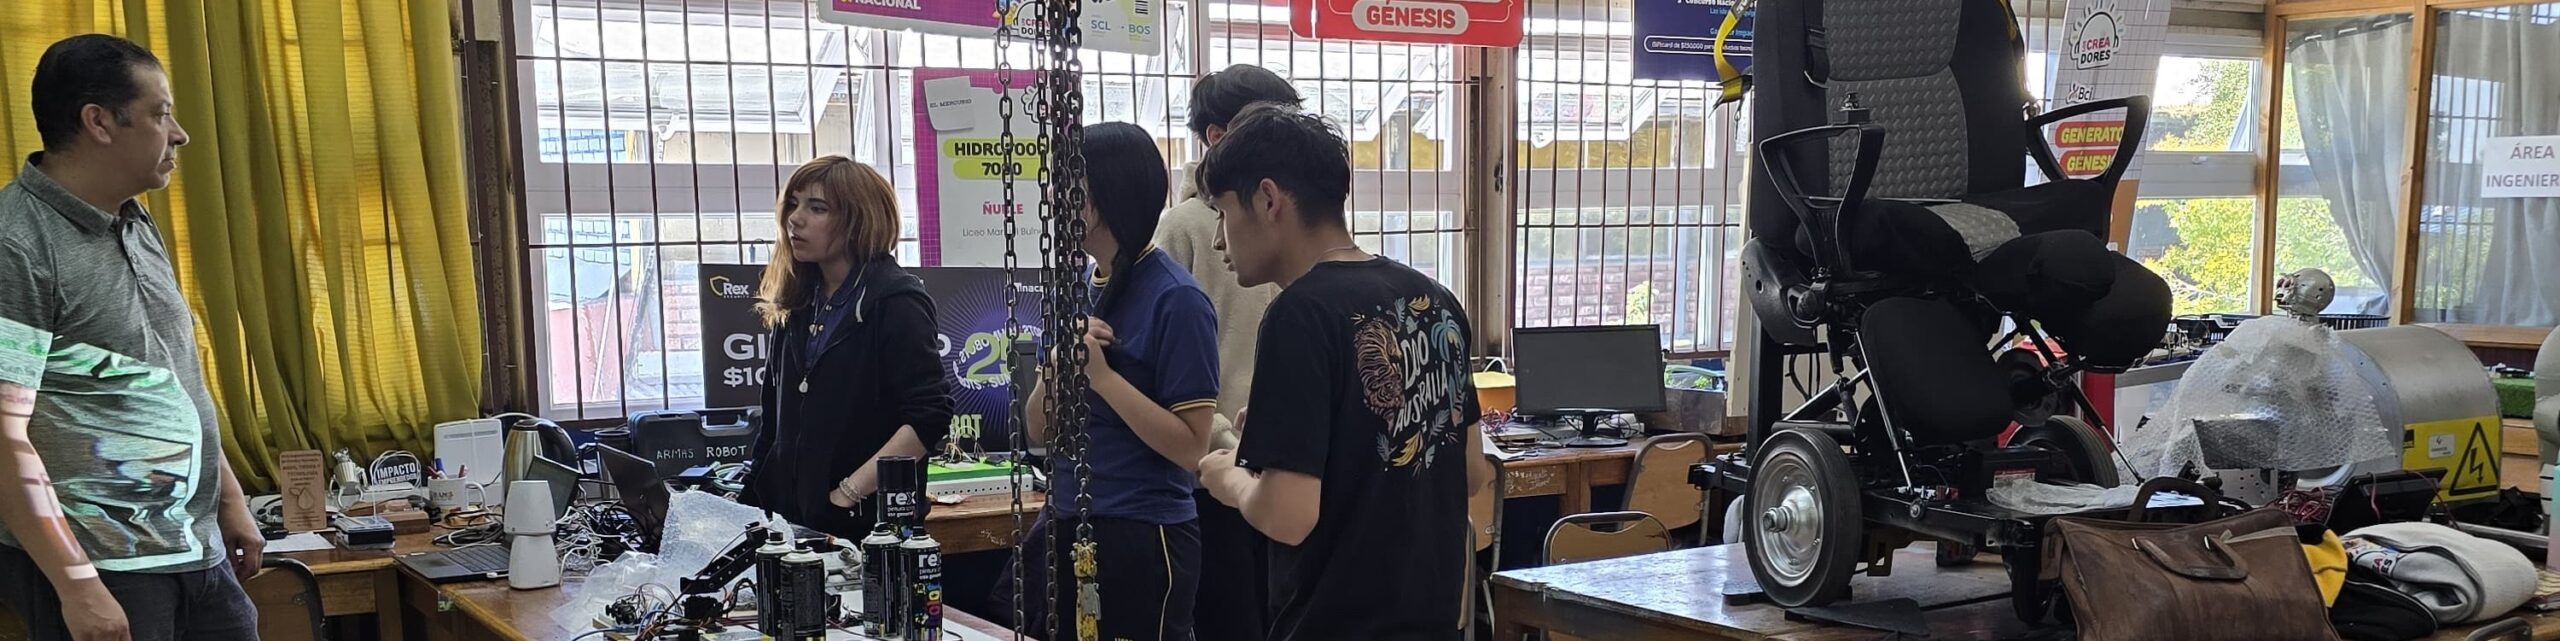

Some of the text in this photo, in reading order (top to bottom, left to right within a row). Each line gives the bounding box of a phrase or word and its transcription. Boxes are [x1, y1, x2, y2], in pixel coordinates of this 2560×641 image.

[855, 0, 921, 10] IONAL
[1366, 0, 1456, 29] GÉNESIS
[1091, 19, 1111, 31] SCL
[1128, 24, 1151, 35] BOS
[2087, 36, 2111, 50] CREA
[2081, 50, 2111, 65] DORES
[954, 142, 1047, 156] HIDROOO
[2510, 142, 2555, 159] ÁREA
[982, 162, 1022, 176] 700
[2486, 174, 2560, 187] INGENIER
[983, 201, 1024, 214] ÑUE
[963, 228, 986, 237] Liceo
[723, 283, 750, 295] Rex
[1393, 361, 1449, 438] AUSRALIA
[706, 445, 747, 458] ROBOT
[376, 462, 416, 480] IMPACTO
[886, 492, 916, 506] rex
